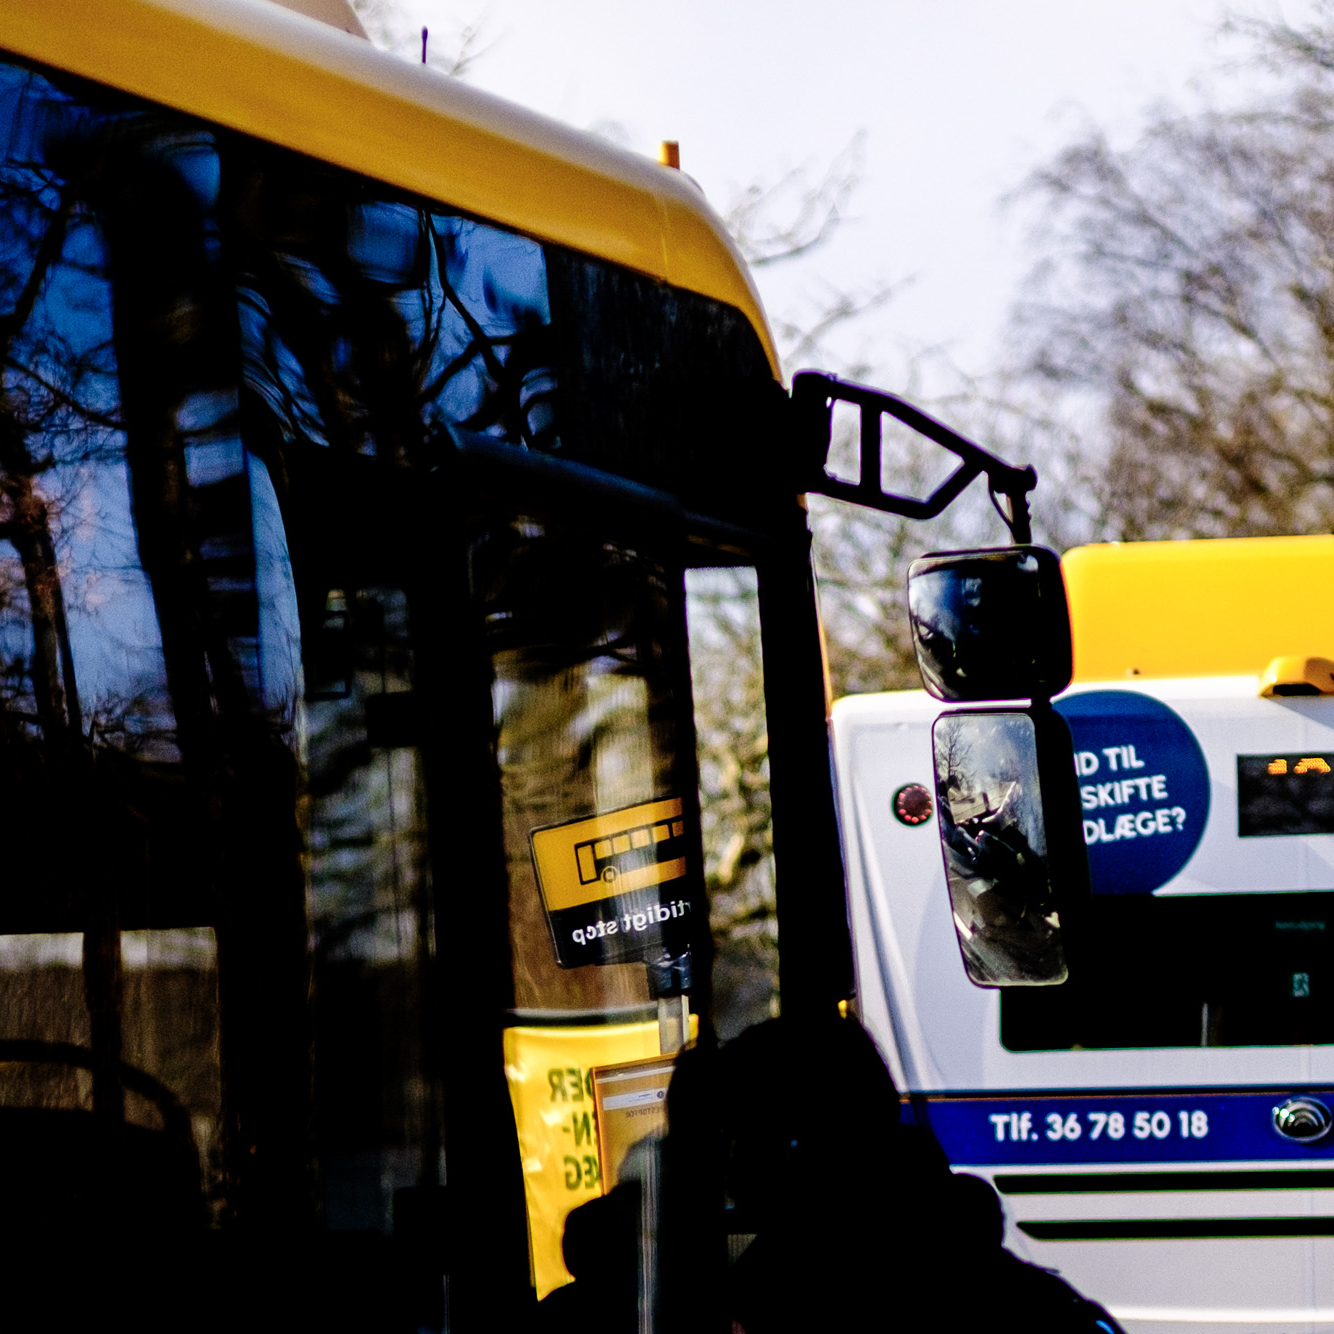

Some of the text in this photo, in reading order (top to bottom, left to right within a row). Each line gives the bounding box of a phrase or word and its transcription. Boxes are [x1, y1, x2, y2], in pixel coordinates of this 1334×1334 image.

[1102, 744, 1145, 771] TIL
[1080, 774, 1168, 810] SKIFTE
[1083, 806, 1186, 845] DLÆGE?
[988, 1110, 1209, 1142] Tlf. 36 78 50 18
